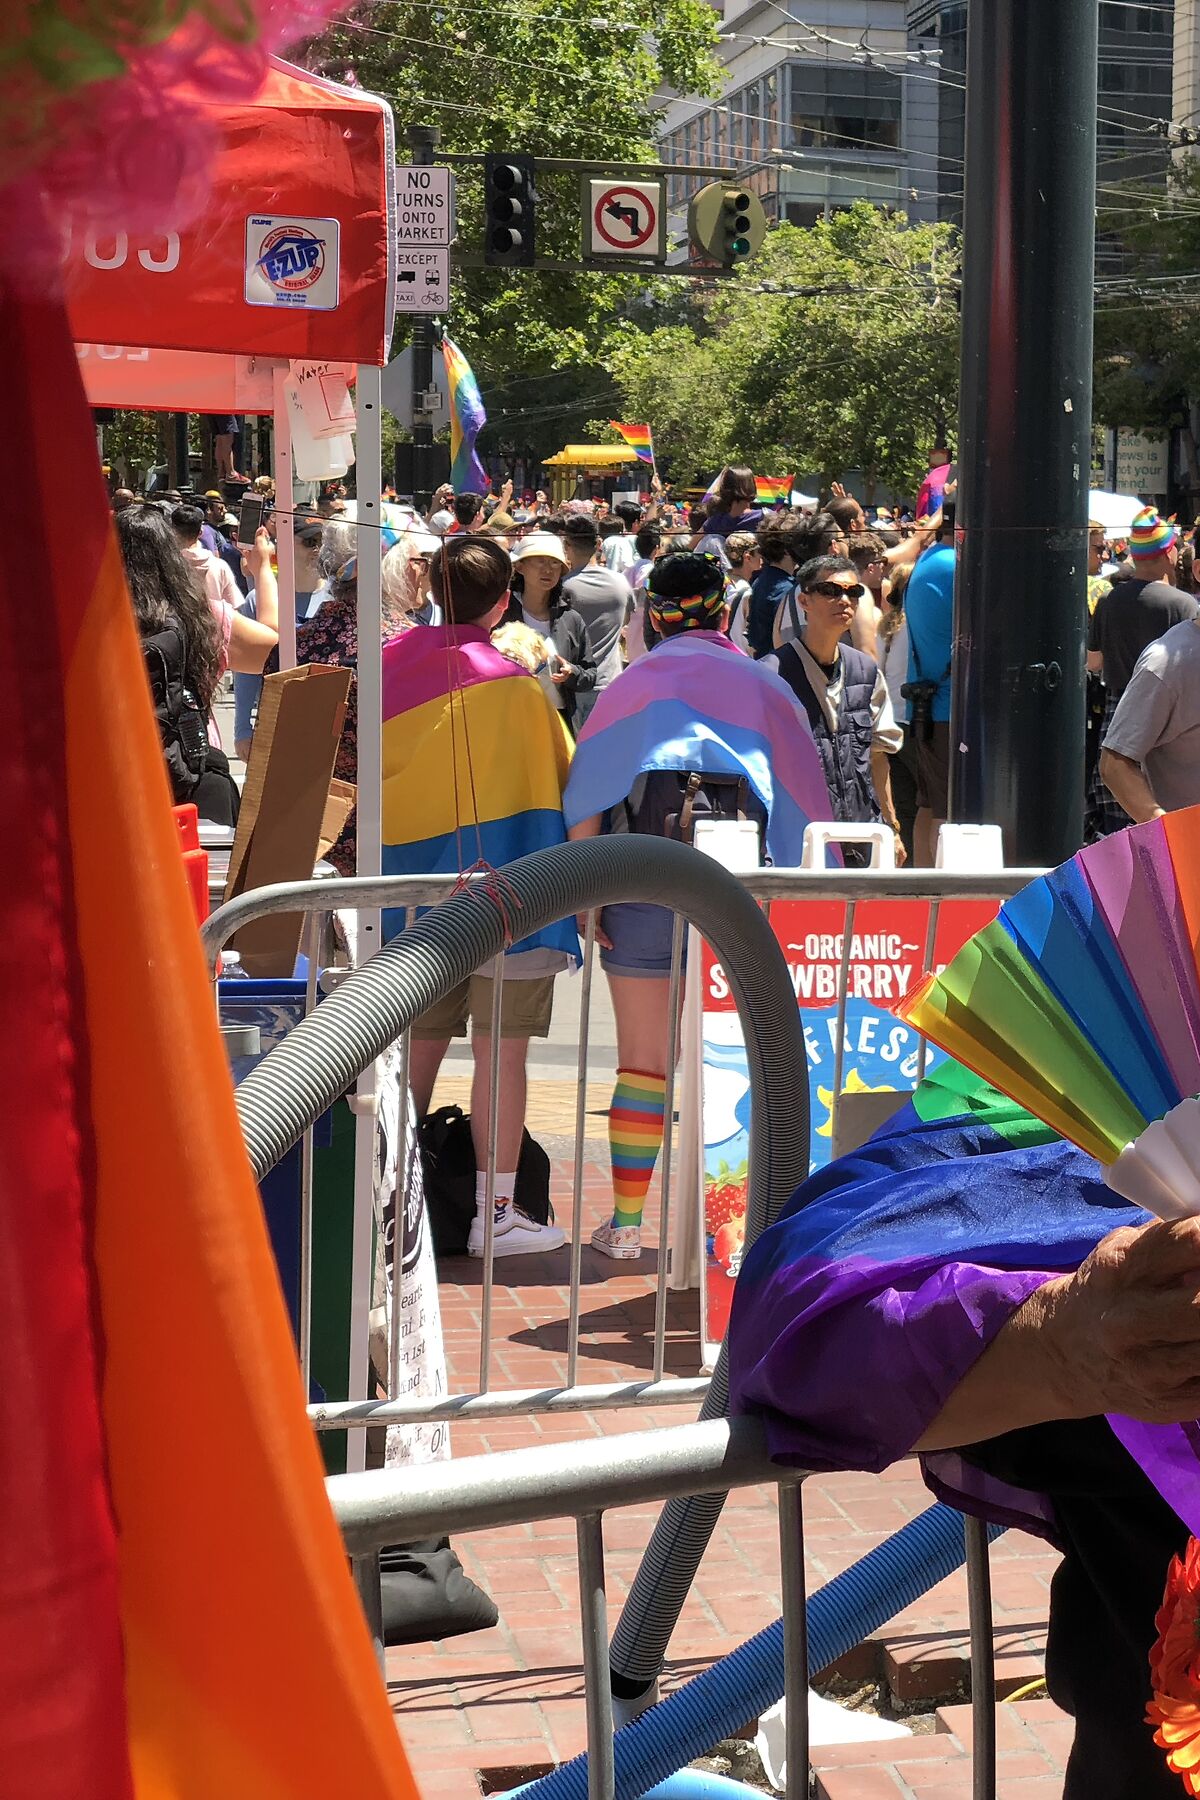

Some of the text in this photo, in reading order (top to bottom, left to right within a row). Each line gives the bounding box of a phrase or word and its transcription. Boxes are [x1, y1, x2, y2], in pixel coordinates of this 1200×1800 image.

[407, 172, 431, 189] NO
[396, 193, 444, 208] TURNS
[402, 212, 435, 224] ONTO
[399, 254, 438, 265] EXCEPT
[297, 363, 329, 385] Water
[1135, 467, 1163, 477] your
